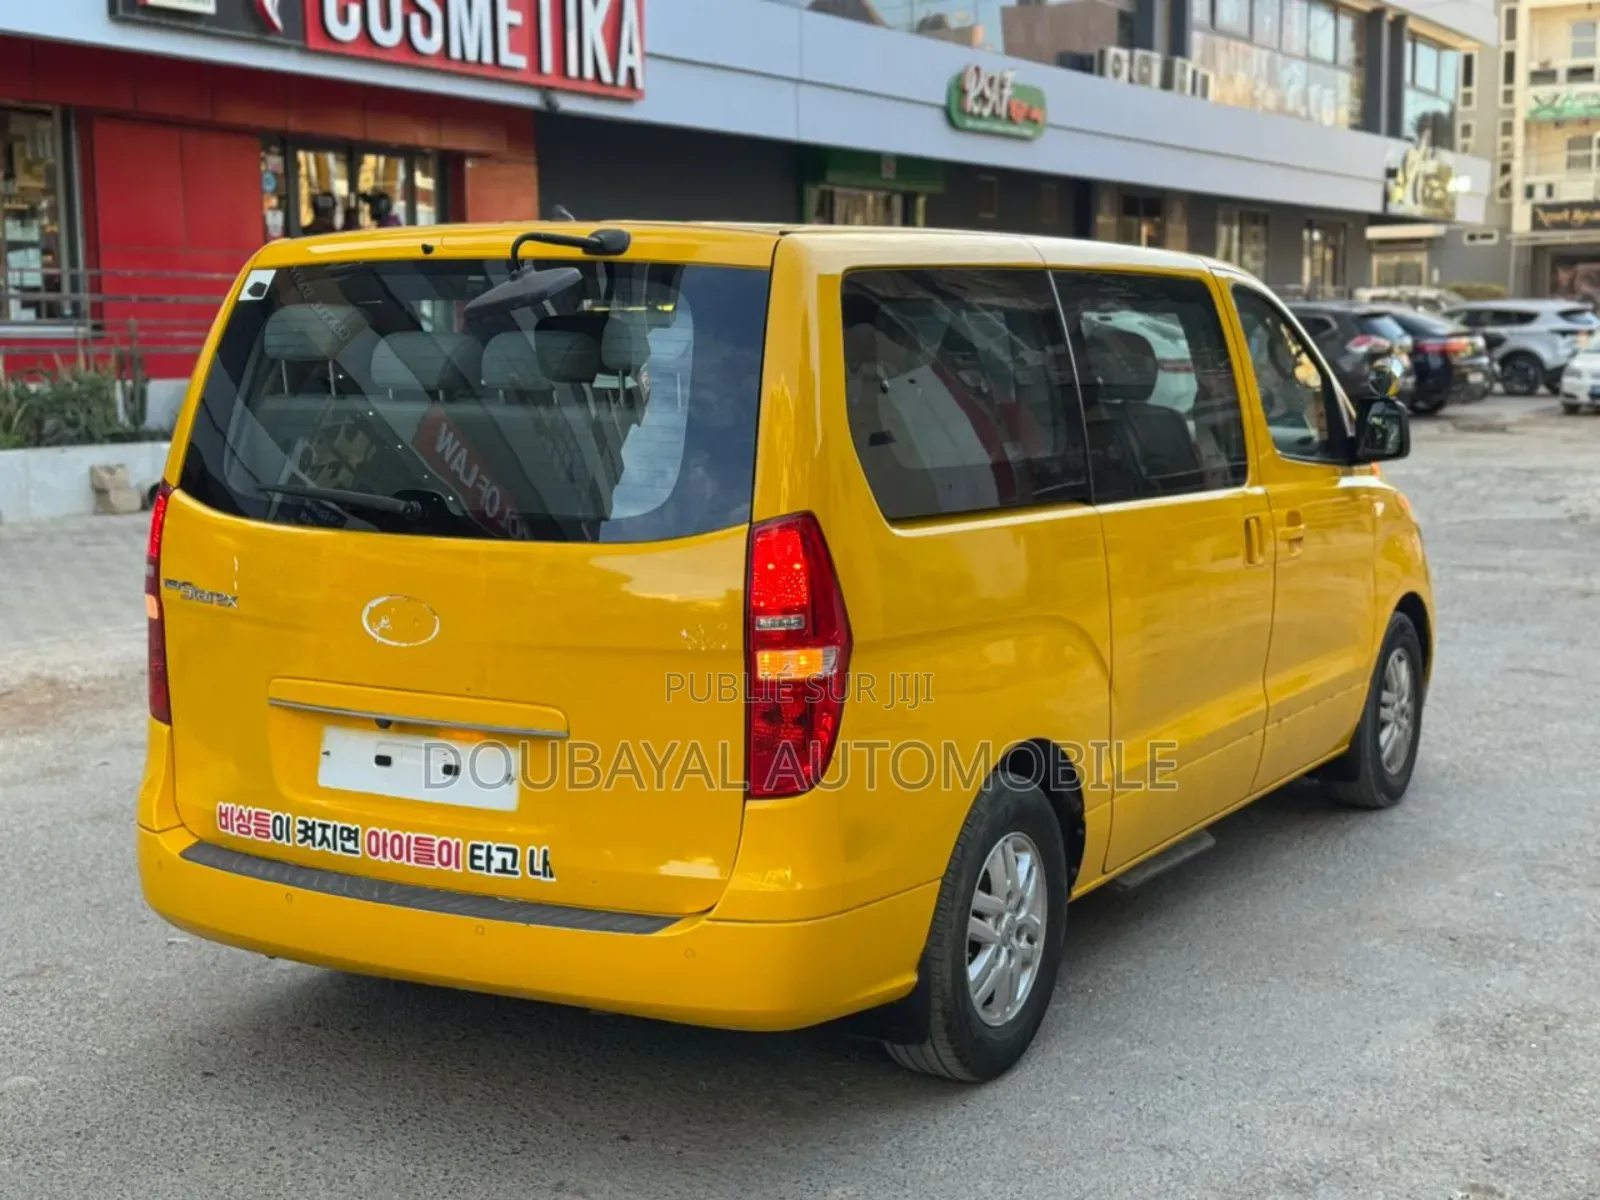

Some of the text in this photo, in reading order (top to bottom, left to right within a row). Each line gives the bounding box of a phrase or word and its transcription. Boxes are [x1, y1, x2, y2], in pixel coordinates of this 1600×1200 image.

[217, 803, 292, 845] 비상등이
[296, 818, 361, 856] 켜지면
[366, 829, 461, 870] 아이들이
[469, 843, 520, 877] 타고
